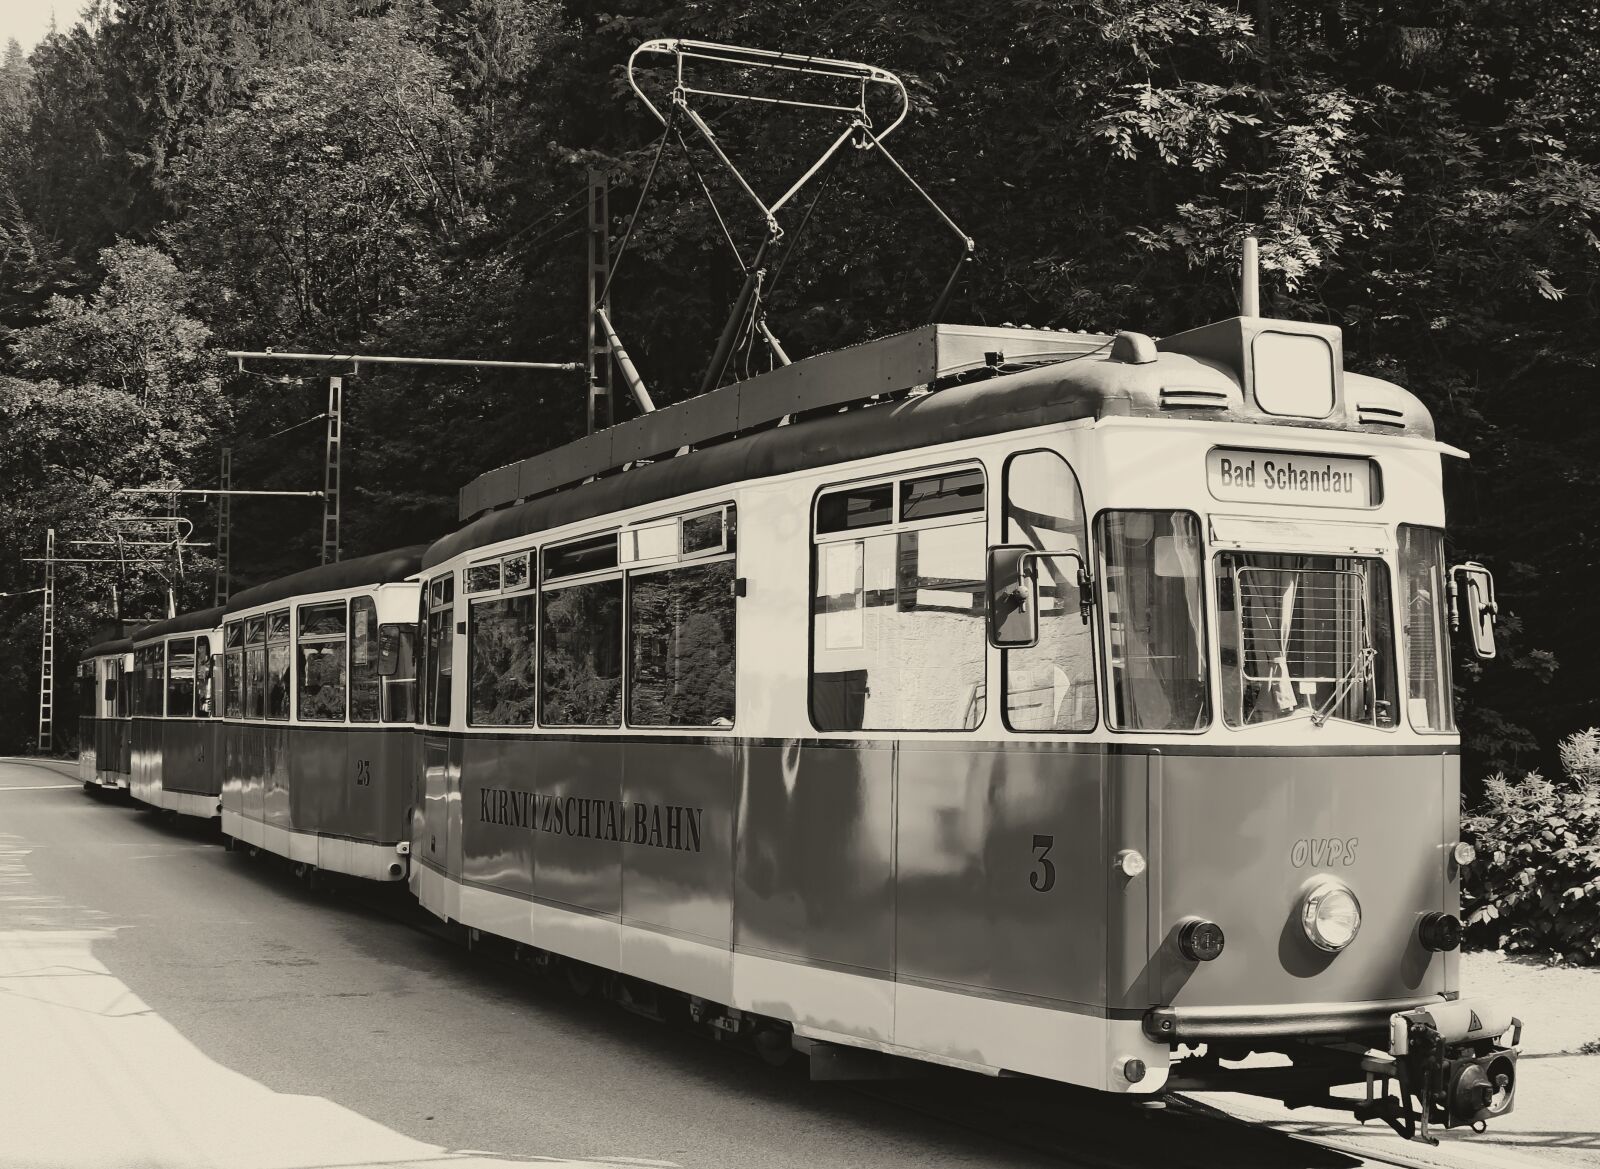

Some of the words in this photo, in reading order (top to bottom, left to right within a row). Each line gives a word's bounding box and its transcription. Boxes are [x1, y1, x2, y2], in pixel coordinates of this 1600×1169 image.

[1220, 458, 1256, 488] Bad
[1263, 460, 1354, 494] Schandau
[480, 787, 704, 853] KIRNITZSCHTALBAHN
[1029, 834, 1056, 893] 3
[1290, 837, 1359, 868] OVPS
